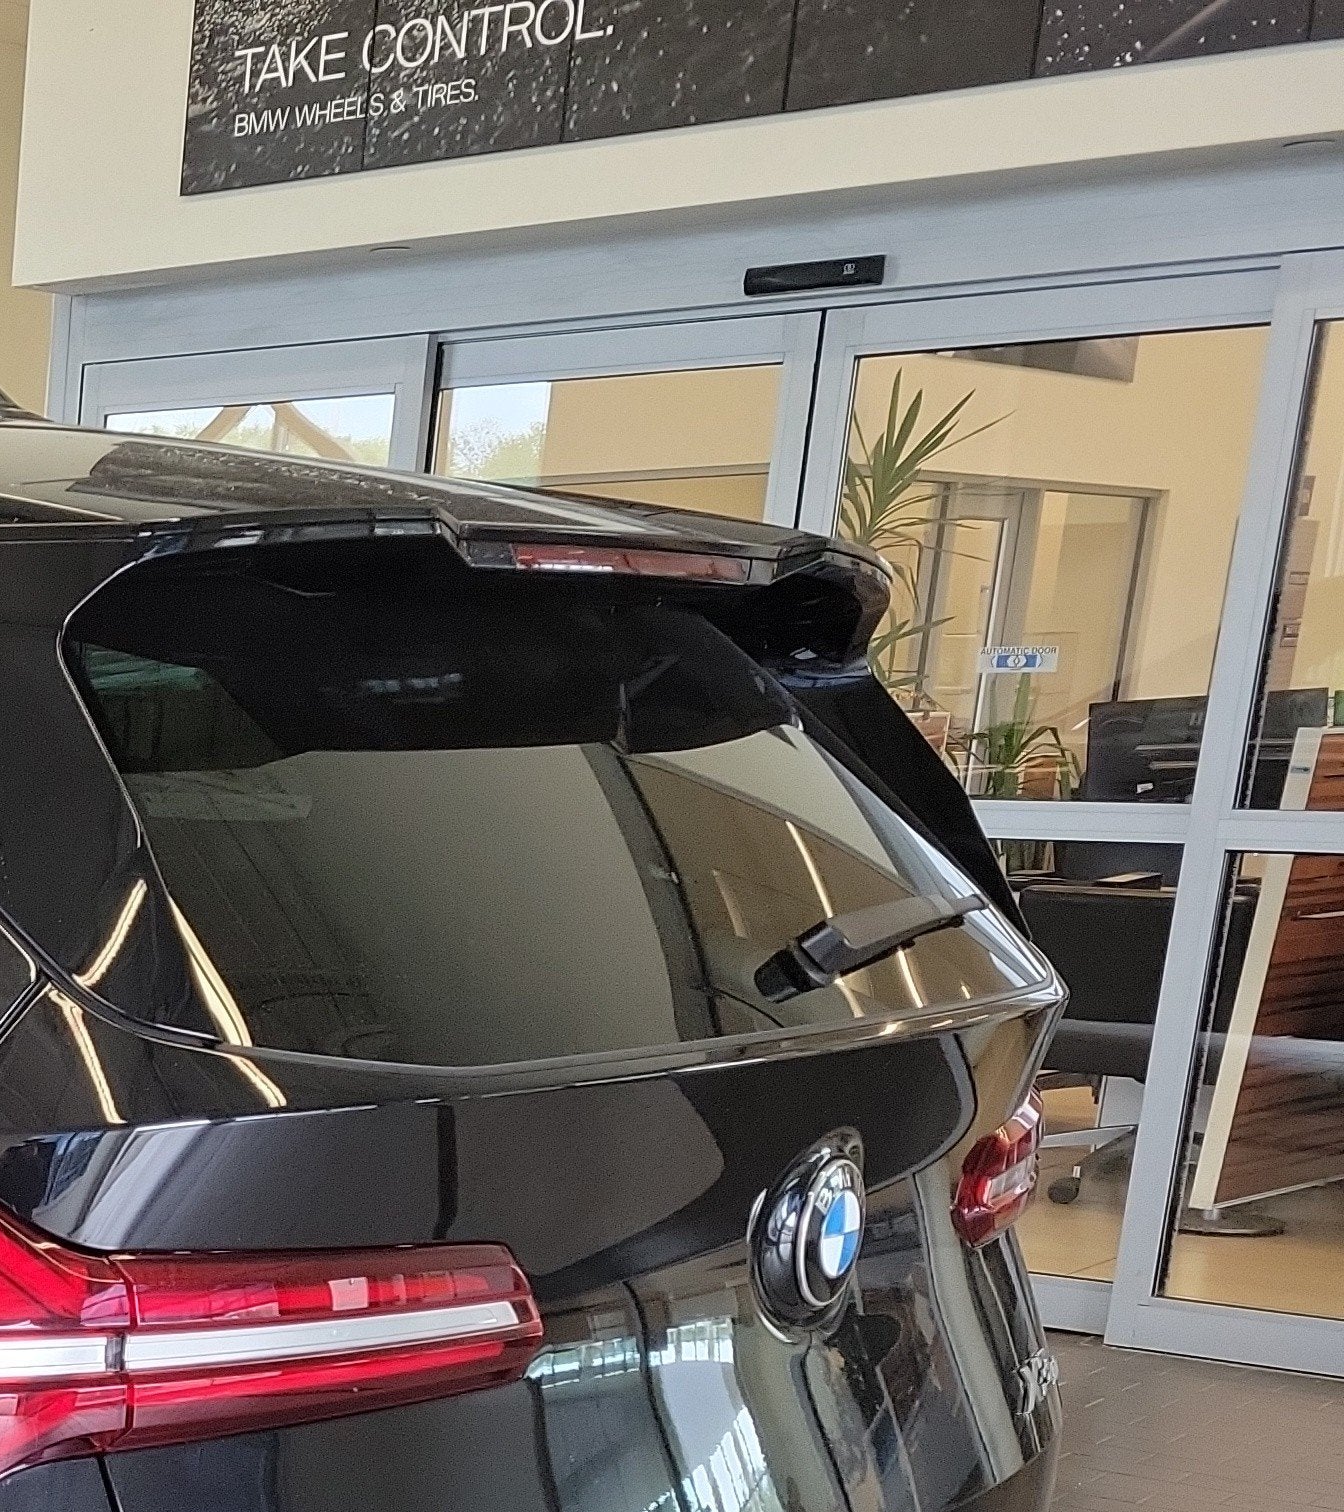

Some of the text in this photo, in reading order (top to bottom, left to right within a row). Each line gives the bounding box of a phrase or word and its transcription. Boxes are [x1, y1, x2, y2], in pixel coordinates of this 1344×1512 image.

[234, 0, 615, 95] TAKE CONTROL.
[234, 78, 479, 138] BMW WHEELS & TIRES.
[980, 646, 1057, 656] AUTOMATIC DOOR
